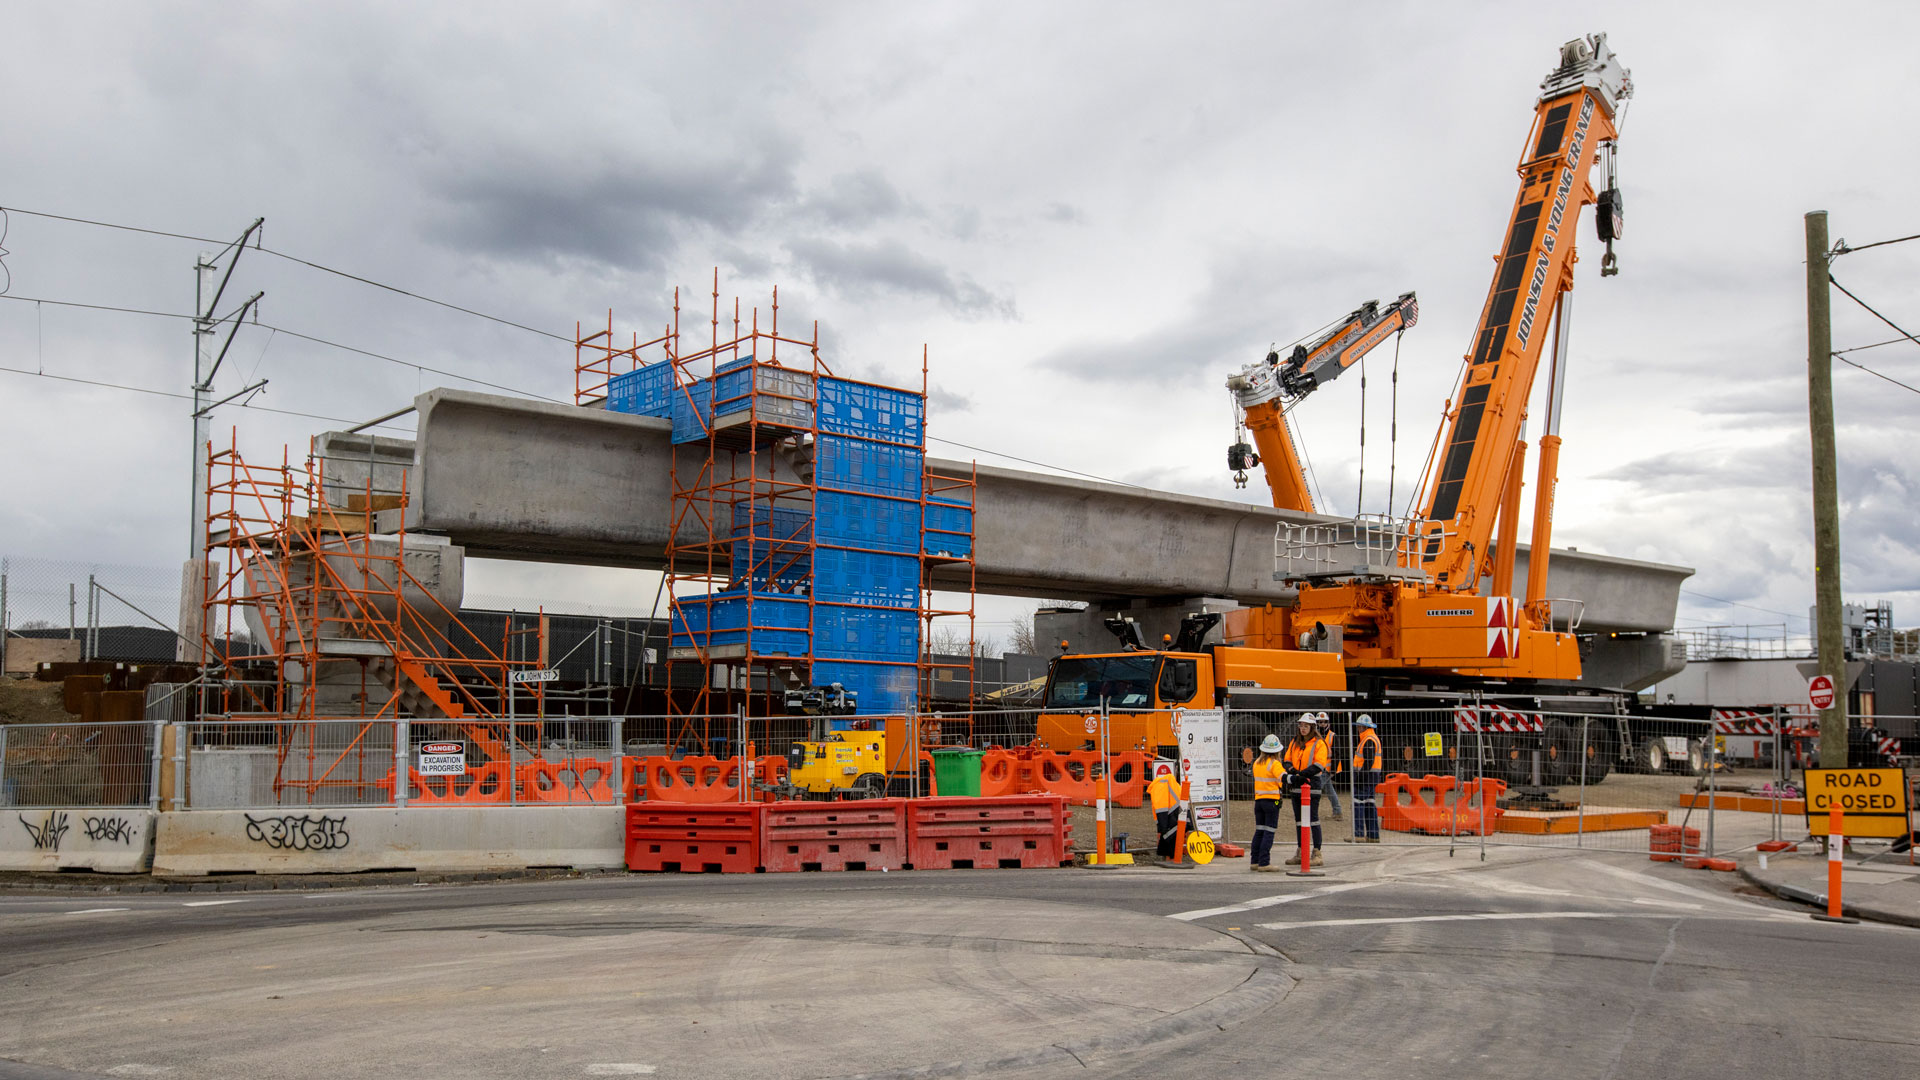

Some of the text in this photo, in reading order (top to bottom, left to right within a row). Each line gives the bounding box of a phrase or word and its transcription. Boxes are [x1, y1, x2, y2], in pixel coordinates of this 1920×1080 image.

[1516, 94, 1595, 352] JOHNSON & YOUNG CRANES
[525, 671, 551, 680] JOHN ST
[1227, 680, 1256, 688] LIEBHERR
[1188, 733, 1193, 744] 9
[1825, 773, 1881, 787] ROAD
[1189, 841, 1213, 854] SLOW
